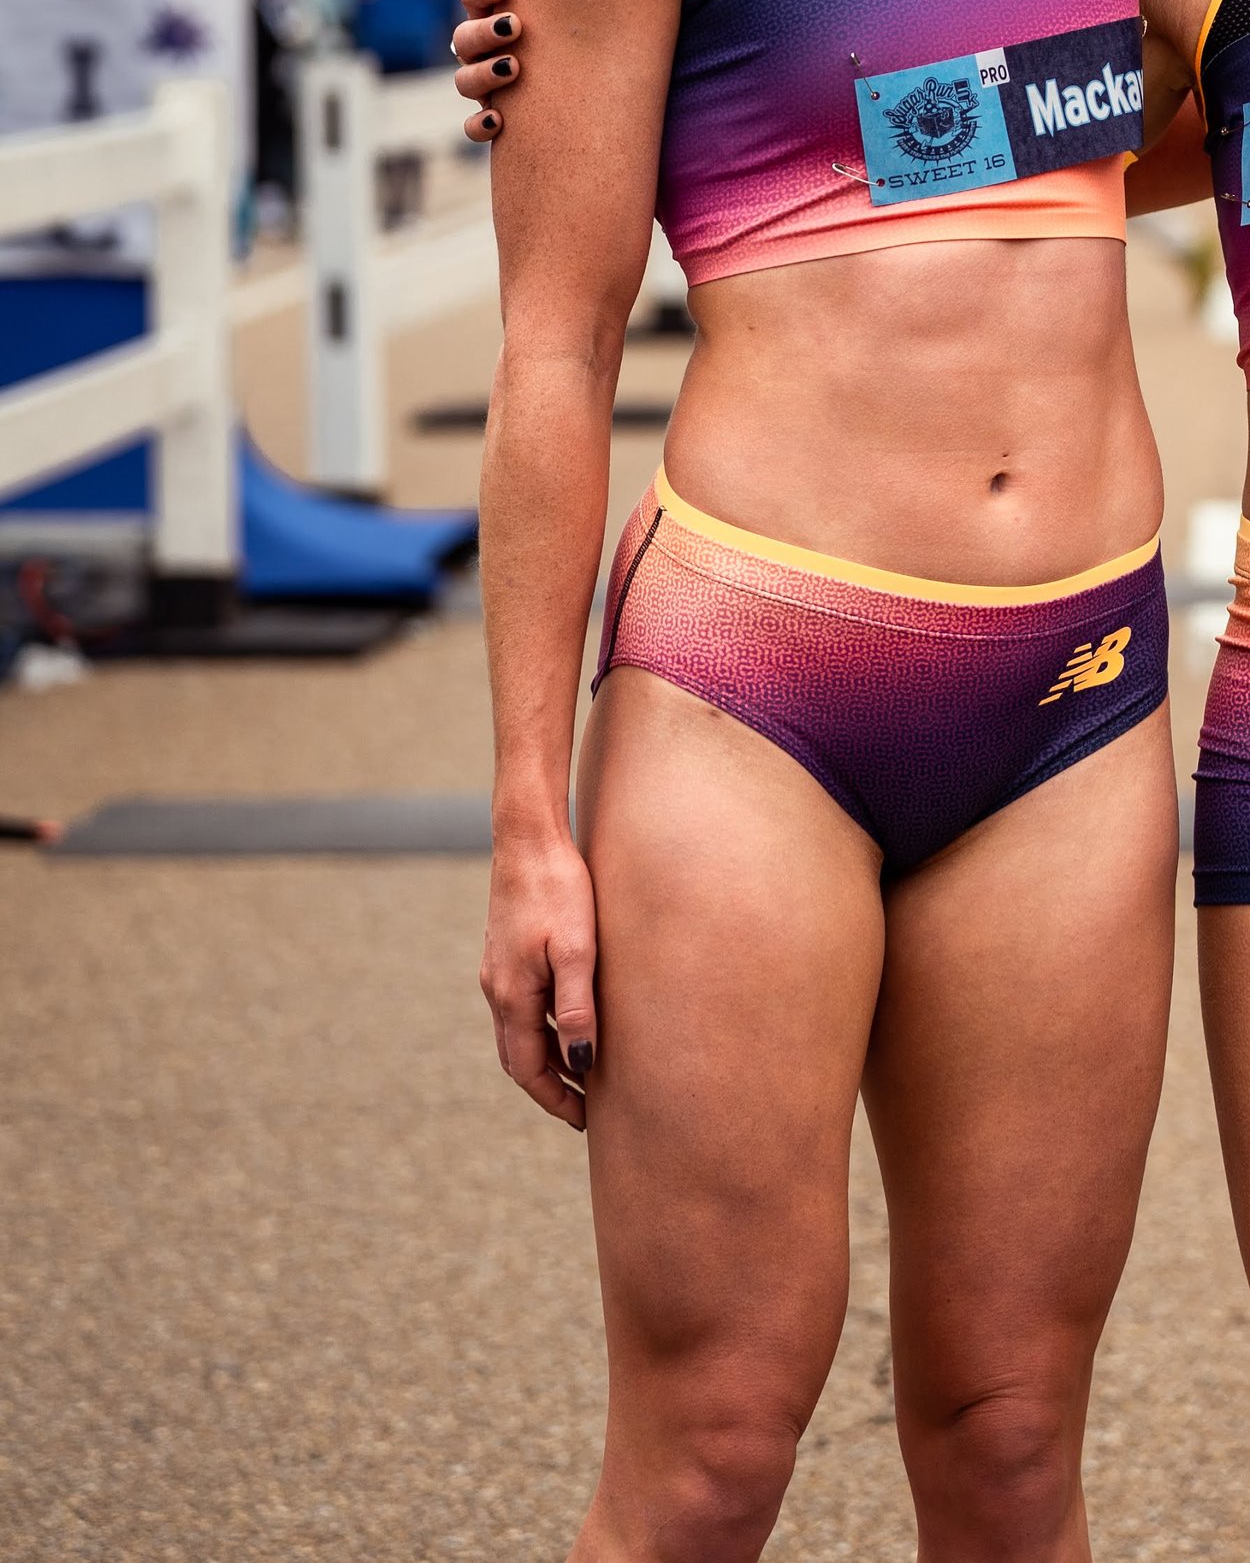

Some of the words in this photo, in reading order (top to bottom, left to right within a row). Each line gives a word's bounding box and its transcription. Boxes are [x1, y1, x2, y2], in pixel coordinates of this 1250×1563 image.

[980, 64, 1008, 86] PRO
[884, 89, 926, 128] Sugar
[925, 78, 954, 101] Run
[888, 161, 977, 189] SWEET
[985, 154, 1006, 170] 16
